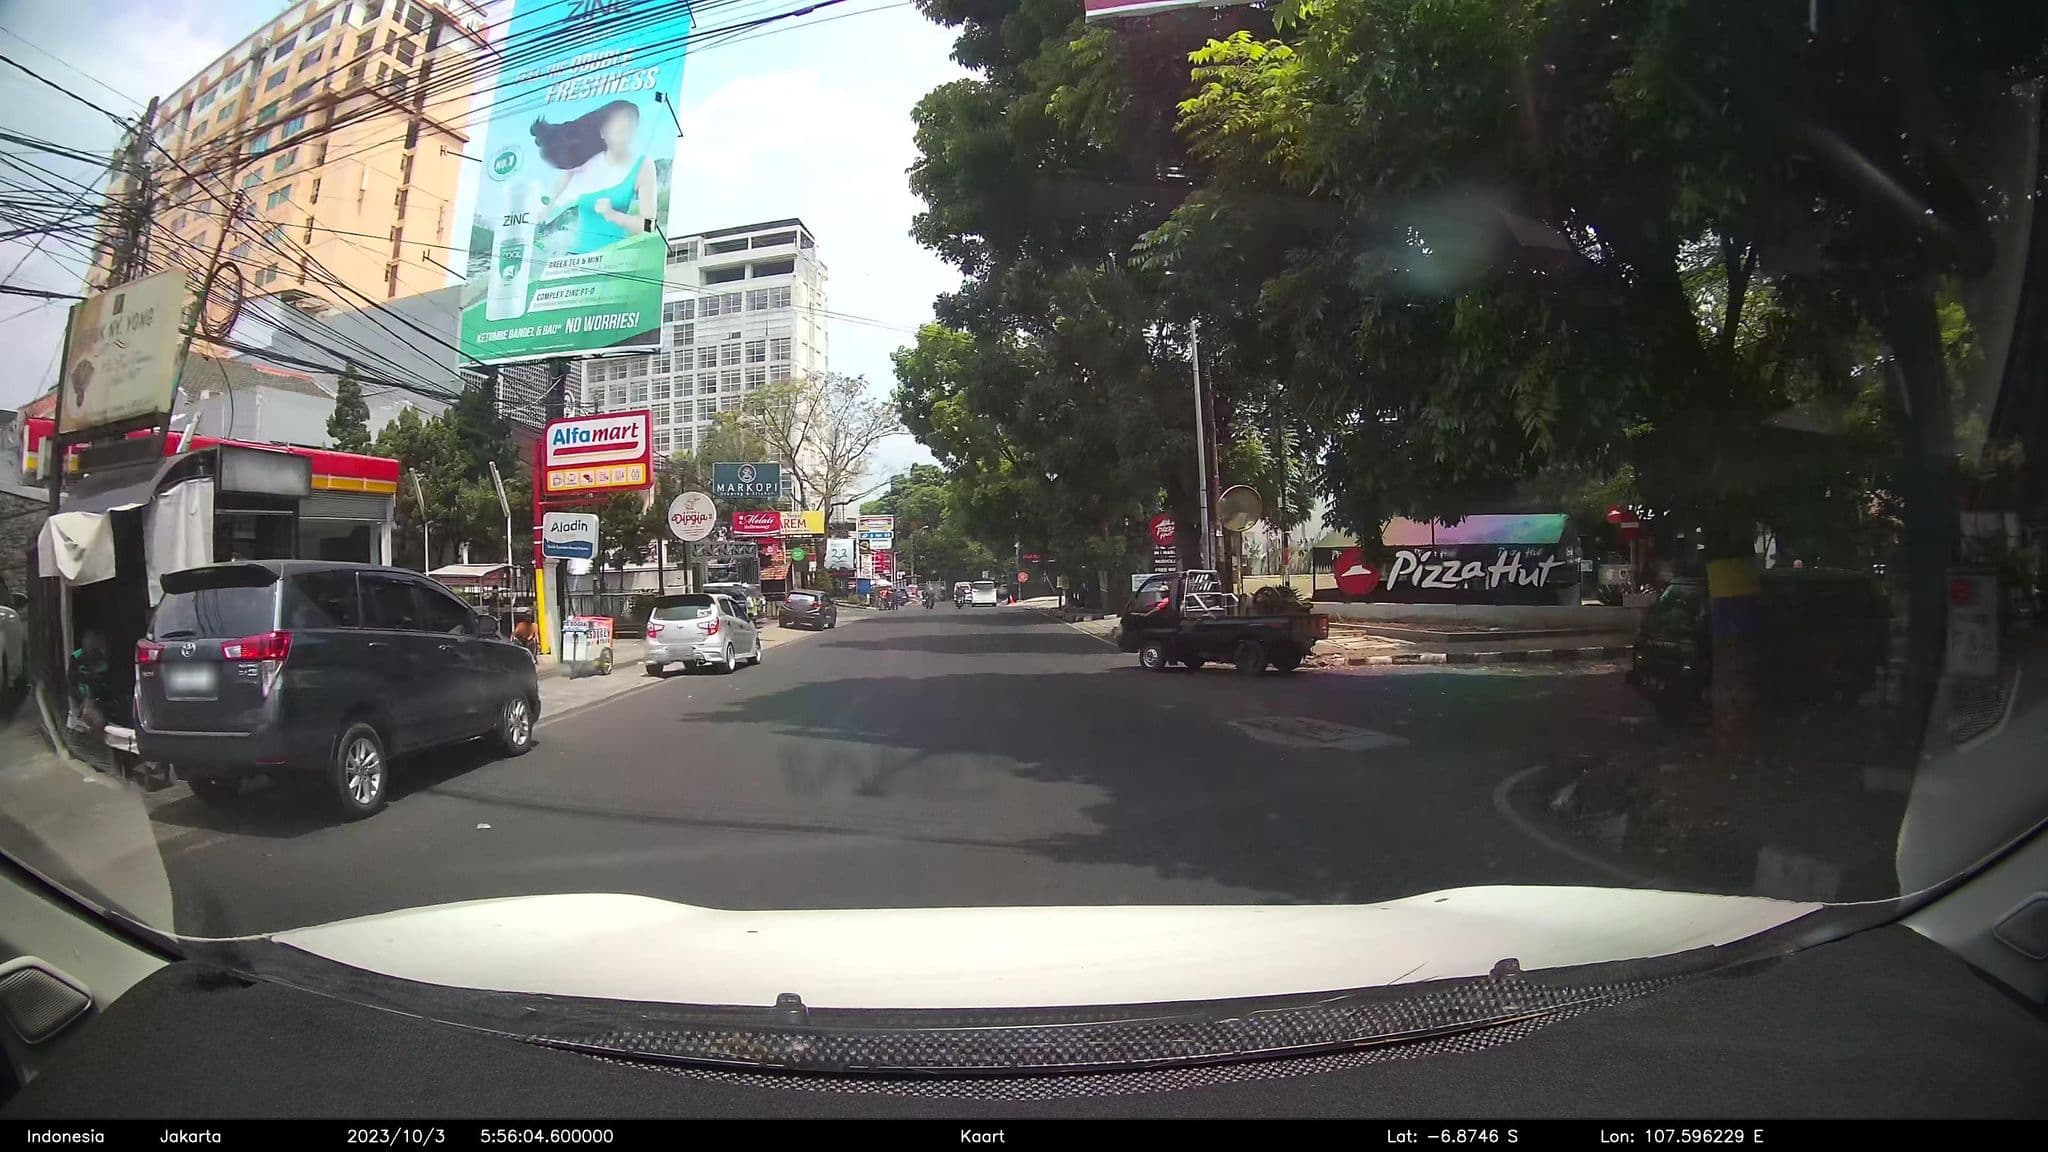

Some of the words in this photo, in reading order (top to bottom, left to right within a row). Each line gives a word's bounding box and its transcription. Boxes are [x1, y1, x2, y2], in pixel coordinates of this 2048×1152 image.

[547, 66, 659, 104] FRESHNESS
[503, 212, 530, 227] ZINC
[536, 290, 565, 302] COMPLEX
[565, 288, 580, 298] ZINC
[475, 330, 508, 344] KETOMBE
[508, 327, 535, 340] BANDEL
[536, 326, 542, 336] &
[565, 317, 582, 334] NO
[583, 311, 640, 333] WORRIES!
[553, 422, 639, 446] Alfamart
[716, 482, 778, 492] MARKOPI
[550, 519, 588, 533] Aladin
[1386, 550, 1486, 592] Pizza
[1488, 550, 1567, 588] Hut
